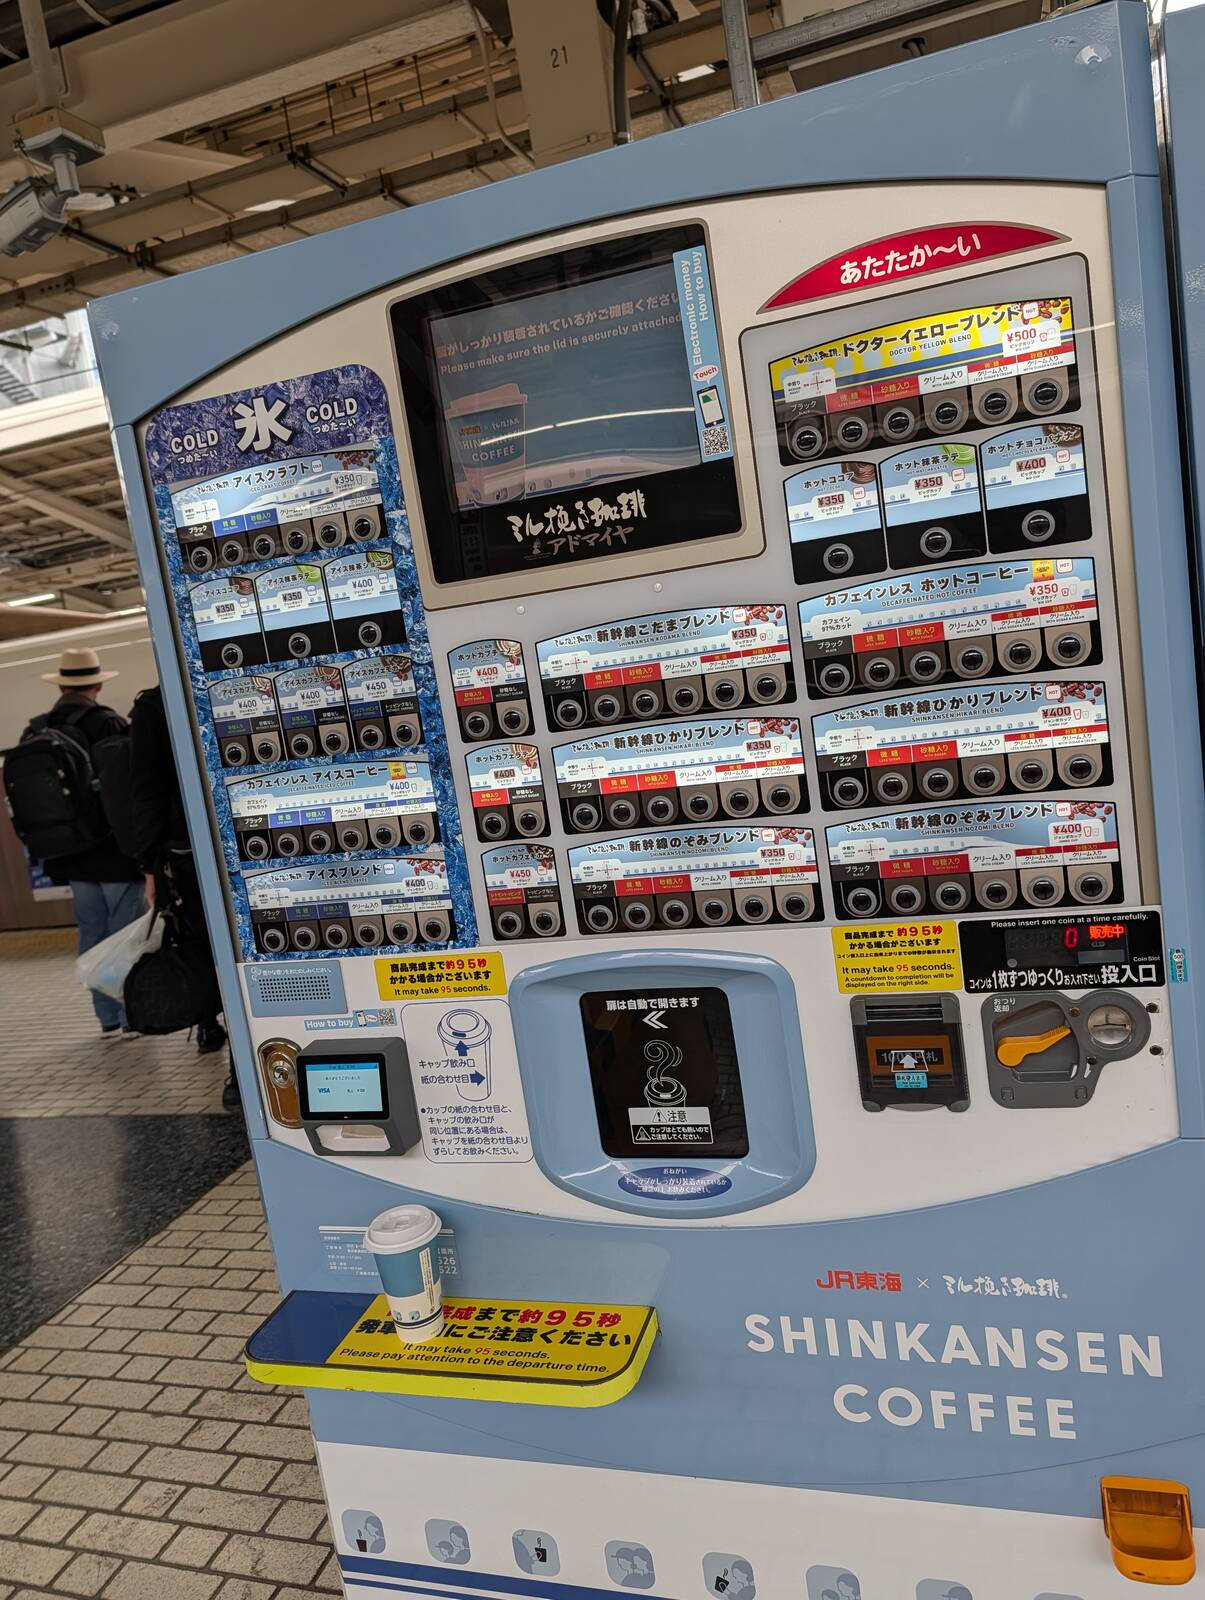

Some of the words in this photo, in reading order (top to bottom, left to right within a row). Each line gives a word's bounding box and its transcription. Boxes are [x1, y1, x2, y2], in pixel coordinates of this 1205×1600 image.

[550, 45, 568, 68] 21
[693, 251, 702, 274] buy
[840, 234, 981, 284] あたたか〜い
[681, 260, 694, 298] money
[695, 277, 704, 290] to
[698, 293, 708, 321] How
[687, 299, 702, 366] Electronic
[843, 306, 1022, 357] ドクターイエローブレンド
[1006, 327, 1037, 343] ¥500
[440, 361, 475, 375] Please
[477, 354, 504, 367] make
[507, 348, 530, 360] sure
[532, 342, 551, 354] the
[553, 338, 567, 350] lid
[569, 336, 579, 346] is
[581, 325, 628, 343] securely
[632, 313, 681, 332] attached
[889, 345, 917, 357] DOCTOR
[919, 339, 947, 351] YELLOW
[949, 333, 972, 344] BLEND
[694, 366, 717, 380] Touch
[923, 370, 963, 385] クリーム入り
[305, 398, 358, 424] COLD
[233, 396, 292, 451] 氷
[171, 430, 219, 454] COLD
[987, 430, 1077, 454] ホットチョコバナナ
[471, 445, 515, 462] COFFEE
[894, 452, 959, 471] ホット抹茶ラテ
[1016, 457, 1046, 472] ¥400
[233, 463, 309, 488] アイスクラフト
[334, 473, 355, 485] ¥350
[803, 472, 855, 489] ホットココア
[914, 476, 943, 489] ¥350
[817, 494, 845, 508] ¥350
[547, 525, 635, 555] アドマイヤ
[351, 579, 373, 589] ¥400
[824, 582, 913, 607] カフェインレス
[920, 567, 1029, 592] ホットコーヒー
[1029, 583, 1059, 596] ¥350
[282, 591, 303, 602] ¥350
[881, 594, 935, 607] DECAFFEINATED
[936, 591, 949, 599] HOT
[952, 587, 977, 596] COFFEE
[596, 611, 730, 643] 新幹線こだまブレンド
[948, 619, 987, 631] クリーム入り
[731, 628, 757, 640] ¥350
[817, 640, 844, 650] ブラック
[476, 666, 498, 676] ¥400
[365, 681, 386, 691] ¥450
[300, 690, 320, 700] ¥400
[883, 687, 1043, 718] 新幹線ひかりブレンド
[911, 713, 955, 722] SHINKANSEN
[956, 709, 980, 718] HIKARI
[1041, 706, 1072, 719] ¥400
[614, 723, 745, 749] 新幹線ひかりブレンド
[746, 740, 772, 752] ¥350
[247, 775, 308, 790] カフェインレス
[312, 766, 388, 782] アイスコーヒー
[389, 781, 410, 791] ¥400
[894, 803, 1053, 830] 新幹線のぞみブレンド
[920, 827, 963, 836] SHINKANSEN
[965, 824, 991, 832] NOZOMI
[1053, 823, 1082, 834] ¥400
[628, 830, 760, 853] 新幹線のぞみブレンド
[760, 848, 785, 858] ¥350
[306, 864, 383, 880] アイスブレンド
[405, 879, 426, 888] ¥400
[1058, 916, 1075, 924] coin
[1112, 913, 1149, 922] carefully.
[1064, 928, 1078, 947] 0
[1089, 924, 1125, 939] 販売中
[849, 938, 941, 950] かかる場合がございます
[842, 966, 851, 974] It
[851, 966, 871, 975] may
[873, 964, 894, 973] take
[896, 964, 909, 972] 95
[911, 962, 955, 971] seconds.
[1100, 964, 1157, 984] 投入口
[389, 970, 491, 984] かかる場合がございます
[394, 988, 400, 996] It
[402, 988, 419, 996] may
[421, 986, 439, 994] take
[440, 985, 452, 993] 95
[453, 984, 491, 993] seconds.
[606, 997, 700, 1011] 扉は自動で開きます
[993, 997, 1016, 1006] おつり
[993, 1005, 1010, 1013] 返却
[306, 1020, 326, 1029] How
[327, 1019, 336, 1027] to
[338, 1018, 354, 1028] buy
[418, 1059, 475, 1068] キャップ飲み口
[421, 1075, 470, 1084] 紙の合わせ目
[428, 1116, 495, 1124] キャップの飲み口が
[667, 1110, 688, 1123] 注意
[429, 1126, 508, 1135] 同じ位置にある場合は、
[431, 1136, 528, 1145] キャップを紙の合わせ目より
[432, 1147, 519, 1156] ずらしてお飲みください。
[663, 1167, 688, 1175] おねがい
[816, 1270, 902, 1292] JR東海
[355, 1319, 631, 1347] 発車にご注意ください
[403, 1343, 412, 1351] It
[414, 1345, 441, 1354] may
[443, 1345, 471, 1354] take
[474, 1347, 491, 1355] 95
[492, 1348, 550, 1359] seconds.
[744, 1313, 1163, 1378] SHINKANSEN
[340, 1348, 380, 1358] Please
[381, 1352, 405, 1360] pay
[407, 1353, 464, 1363] attention
[483, 1357, 504, 1366] the
[507, 1359, 574, 1371] departure
[576, 1362, 610, 1373] time.
[833, 1384, 1077, 1440] COFFEE
